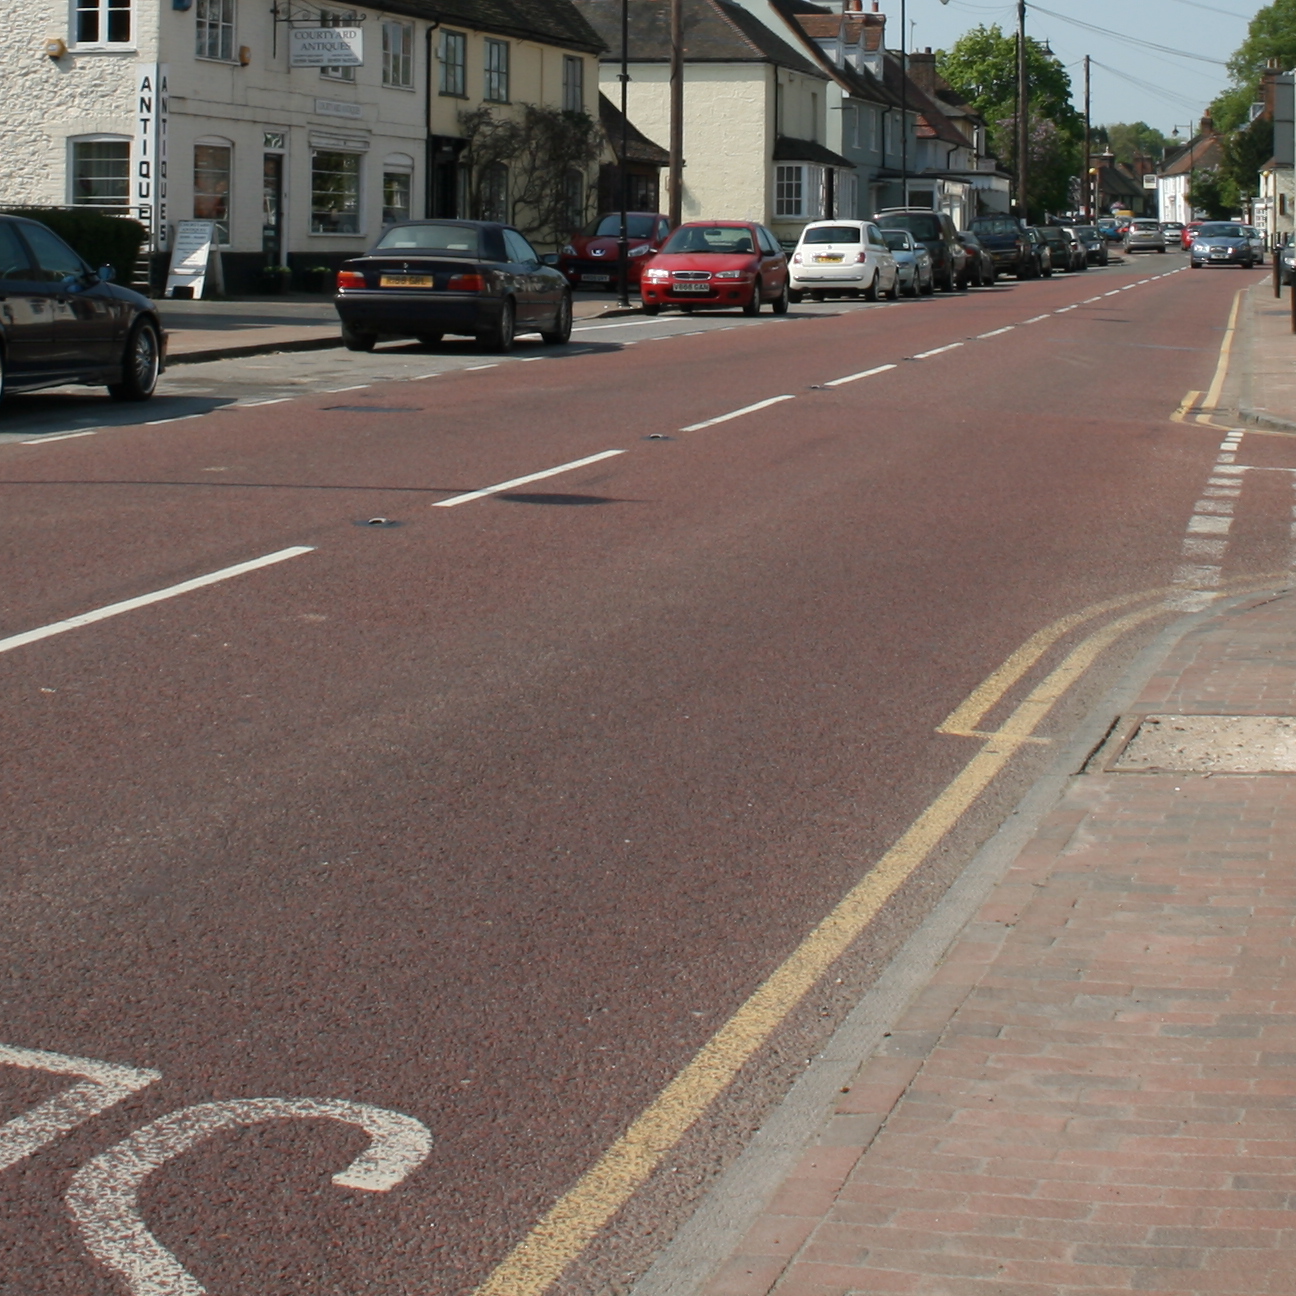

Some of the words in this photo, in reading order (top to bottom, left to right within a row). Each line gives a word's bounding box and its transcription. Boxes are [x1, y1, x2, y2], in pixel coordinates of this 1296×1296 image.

[294, 30, 357, 40] COURTYARD
[300, 41, 352, 52] ANTIQUES
[160, 75, 168, 242] ANTIQUES
